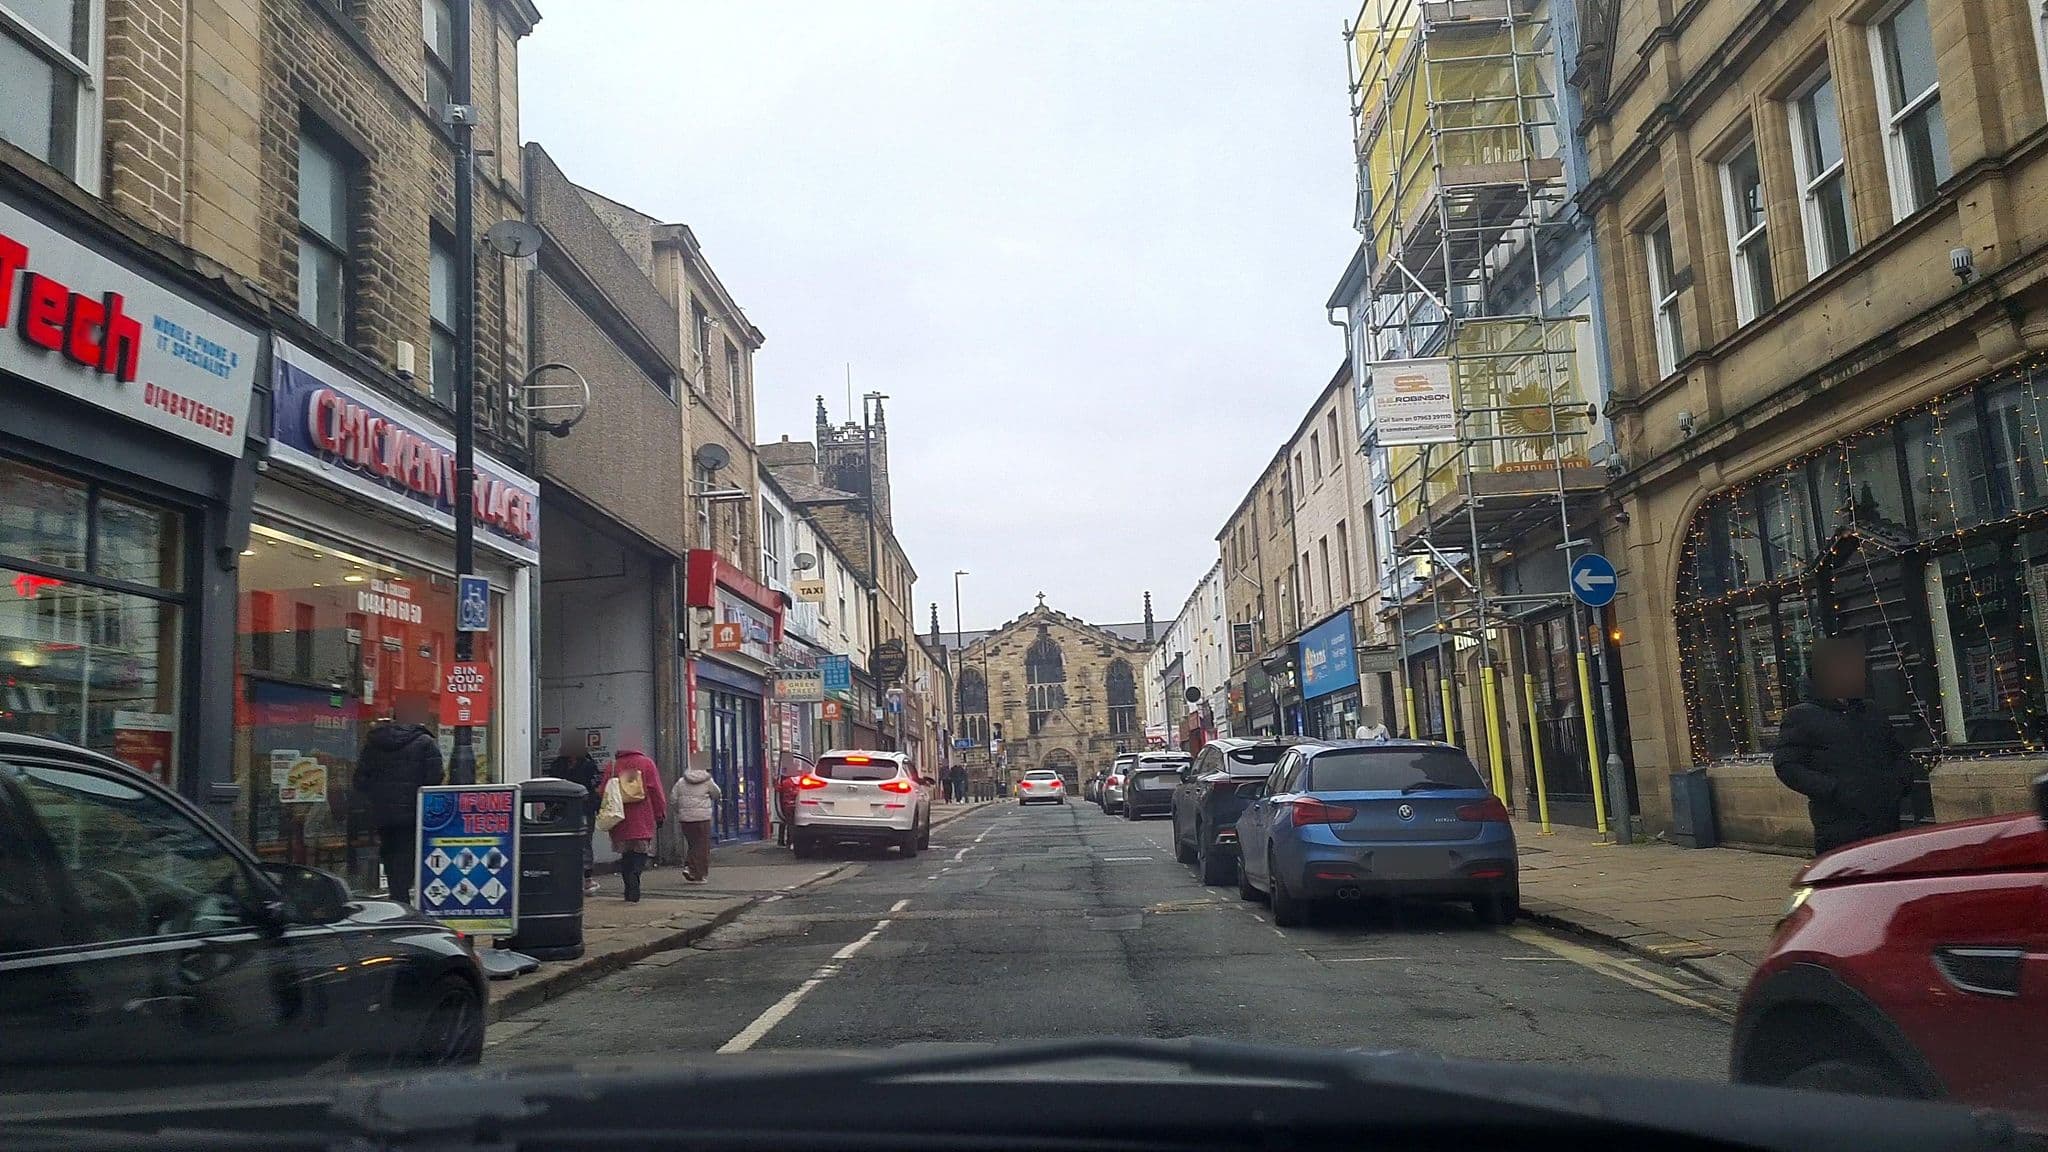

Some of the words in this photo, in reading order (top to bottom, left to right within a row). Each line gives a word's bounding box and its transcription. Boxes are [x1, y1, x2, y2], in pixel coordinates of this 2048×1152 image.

[0, 233, 143, 383] Tech
[309, 388, 441, 498] CHICKEN
[800, 587, 824, 595] TAXI
[453, 666, 477, 675] BIN
[446, 675, 485, 684] YOUR
[462, 813, 509, 833] TECH
